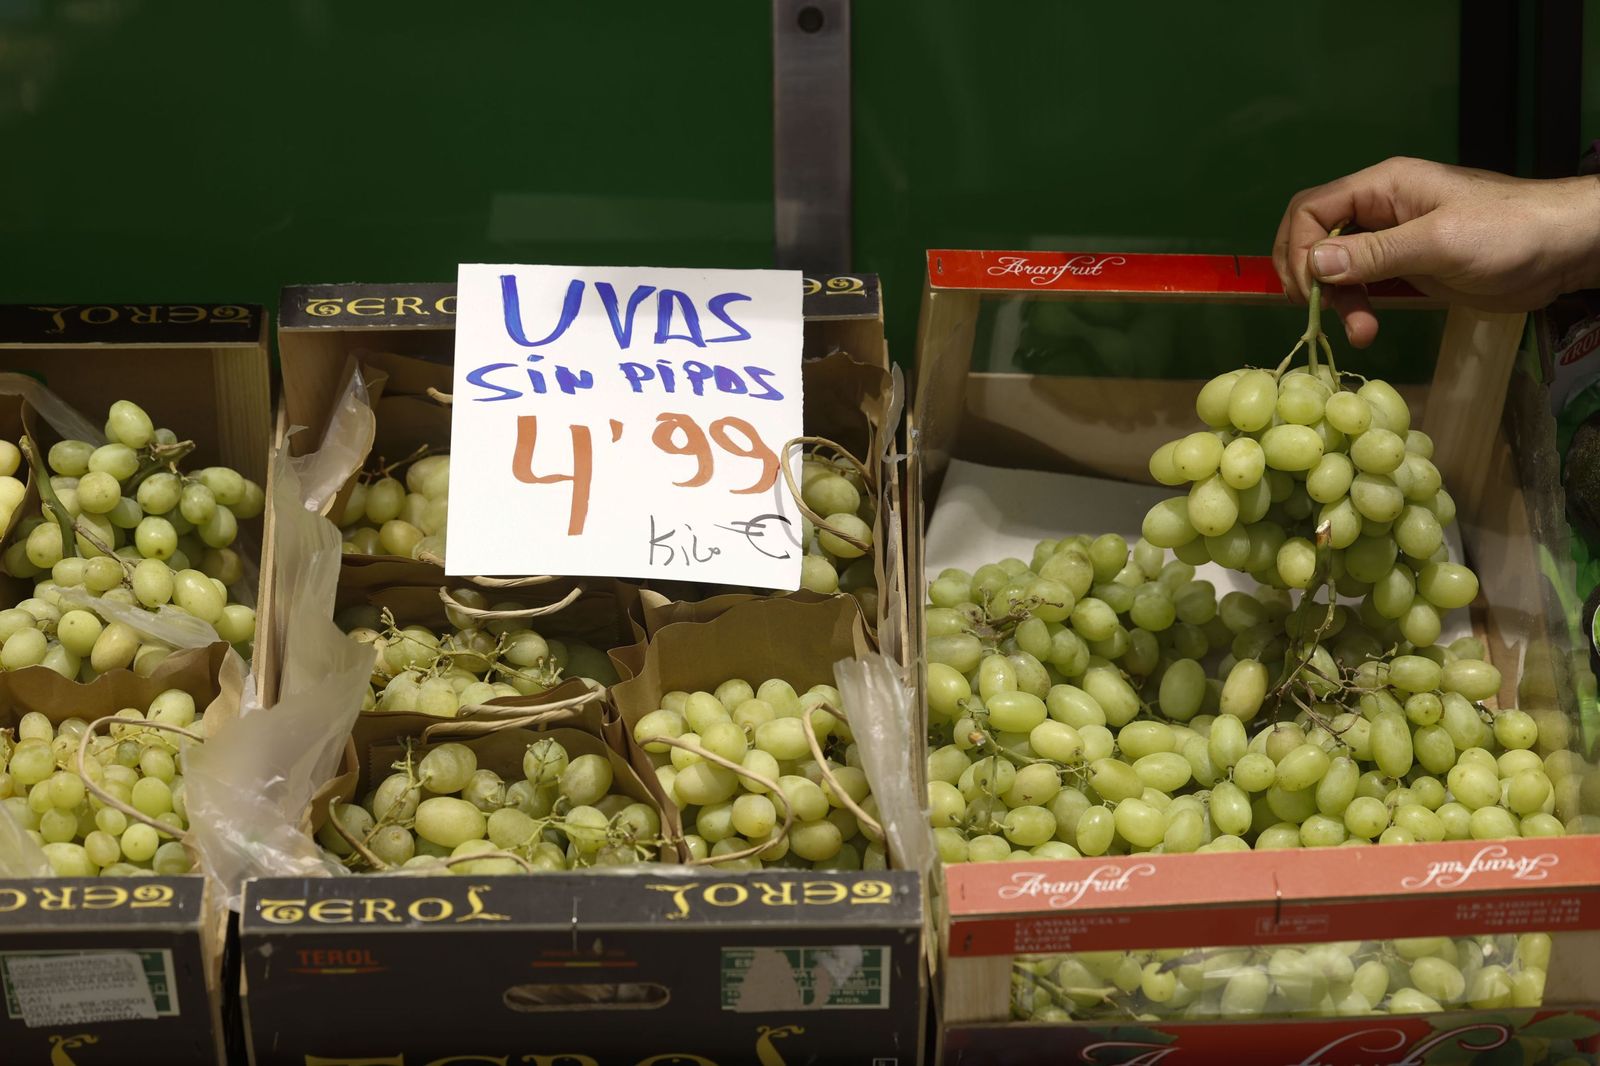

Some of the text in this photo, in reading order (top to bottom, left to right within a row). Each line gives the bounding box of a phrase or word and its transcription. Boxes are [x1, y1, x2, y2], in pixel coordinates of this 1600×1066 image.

[987, 255, 1126, 285] Aranfrut
[28, 305, 251, 334] TEROL
[305, 296, 457, 318] TERO
[498, 273, 753, 350] UVAS
[1400, 844, 1560, 890] Aranfrut
[0, 884, 174, 912] TERO
[645, 880, 893, 920] TEROL
[998, 862, 1156, 909] Aranfrut
[259, 884, 512, 924] TEROL
[298, 949, 380, 966] TEROL
